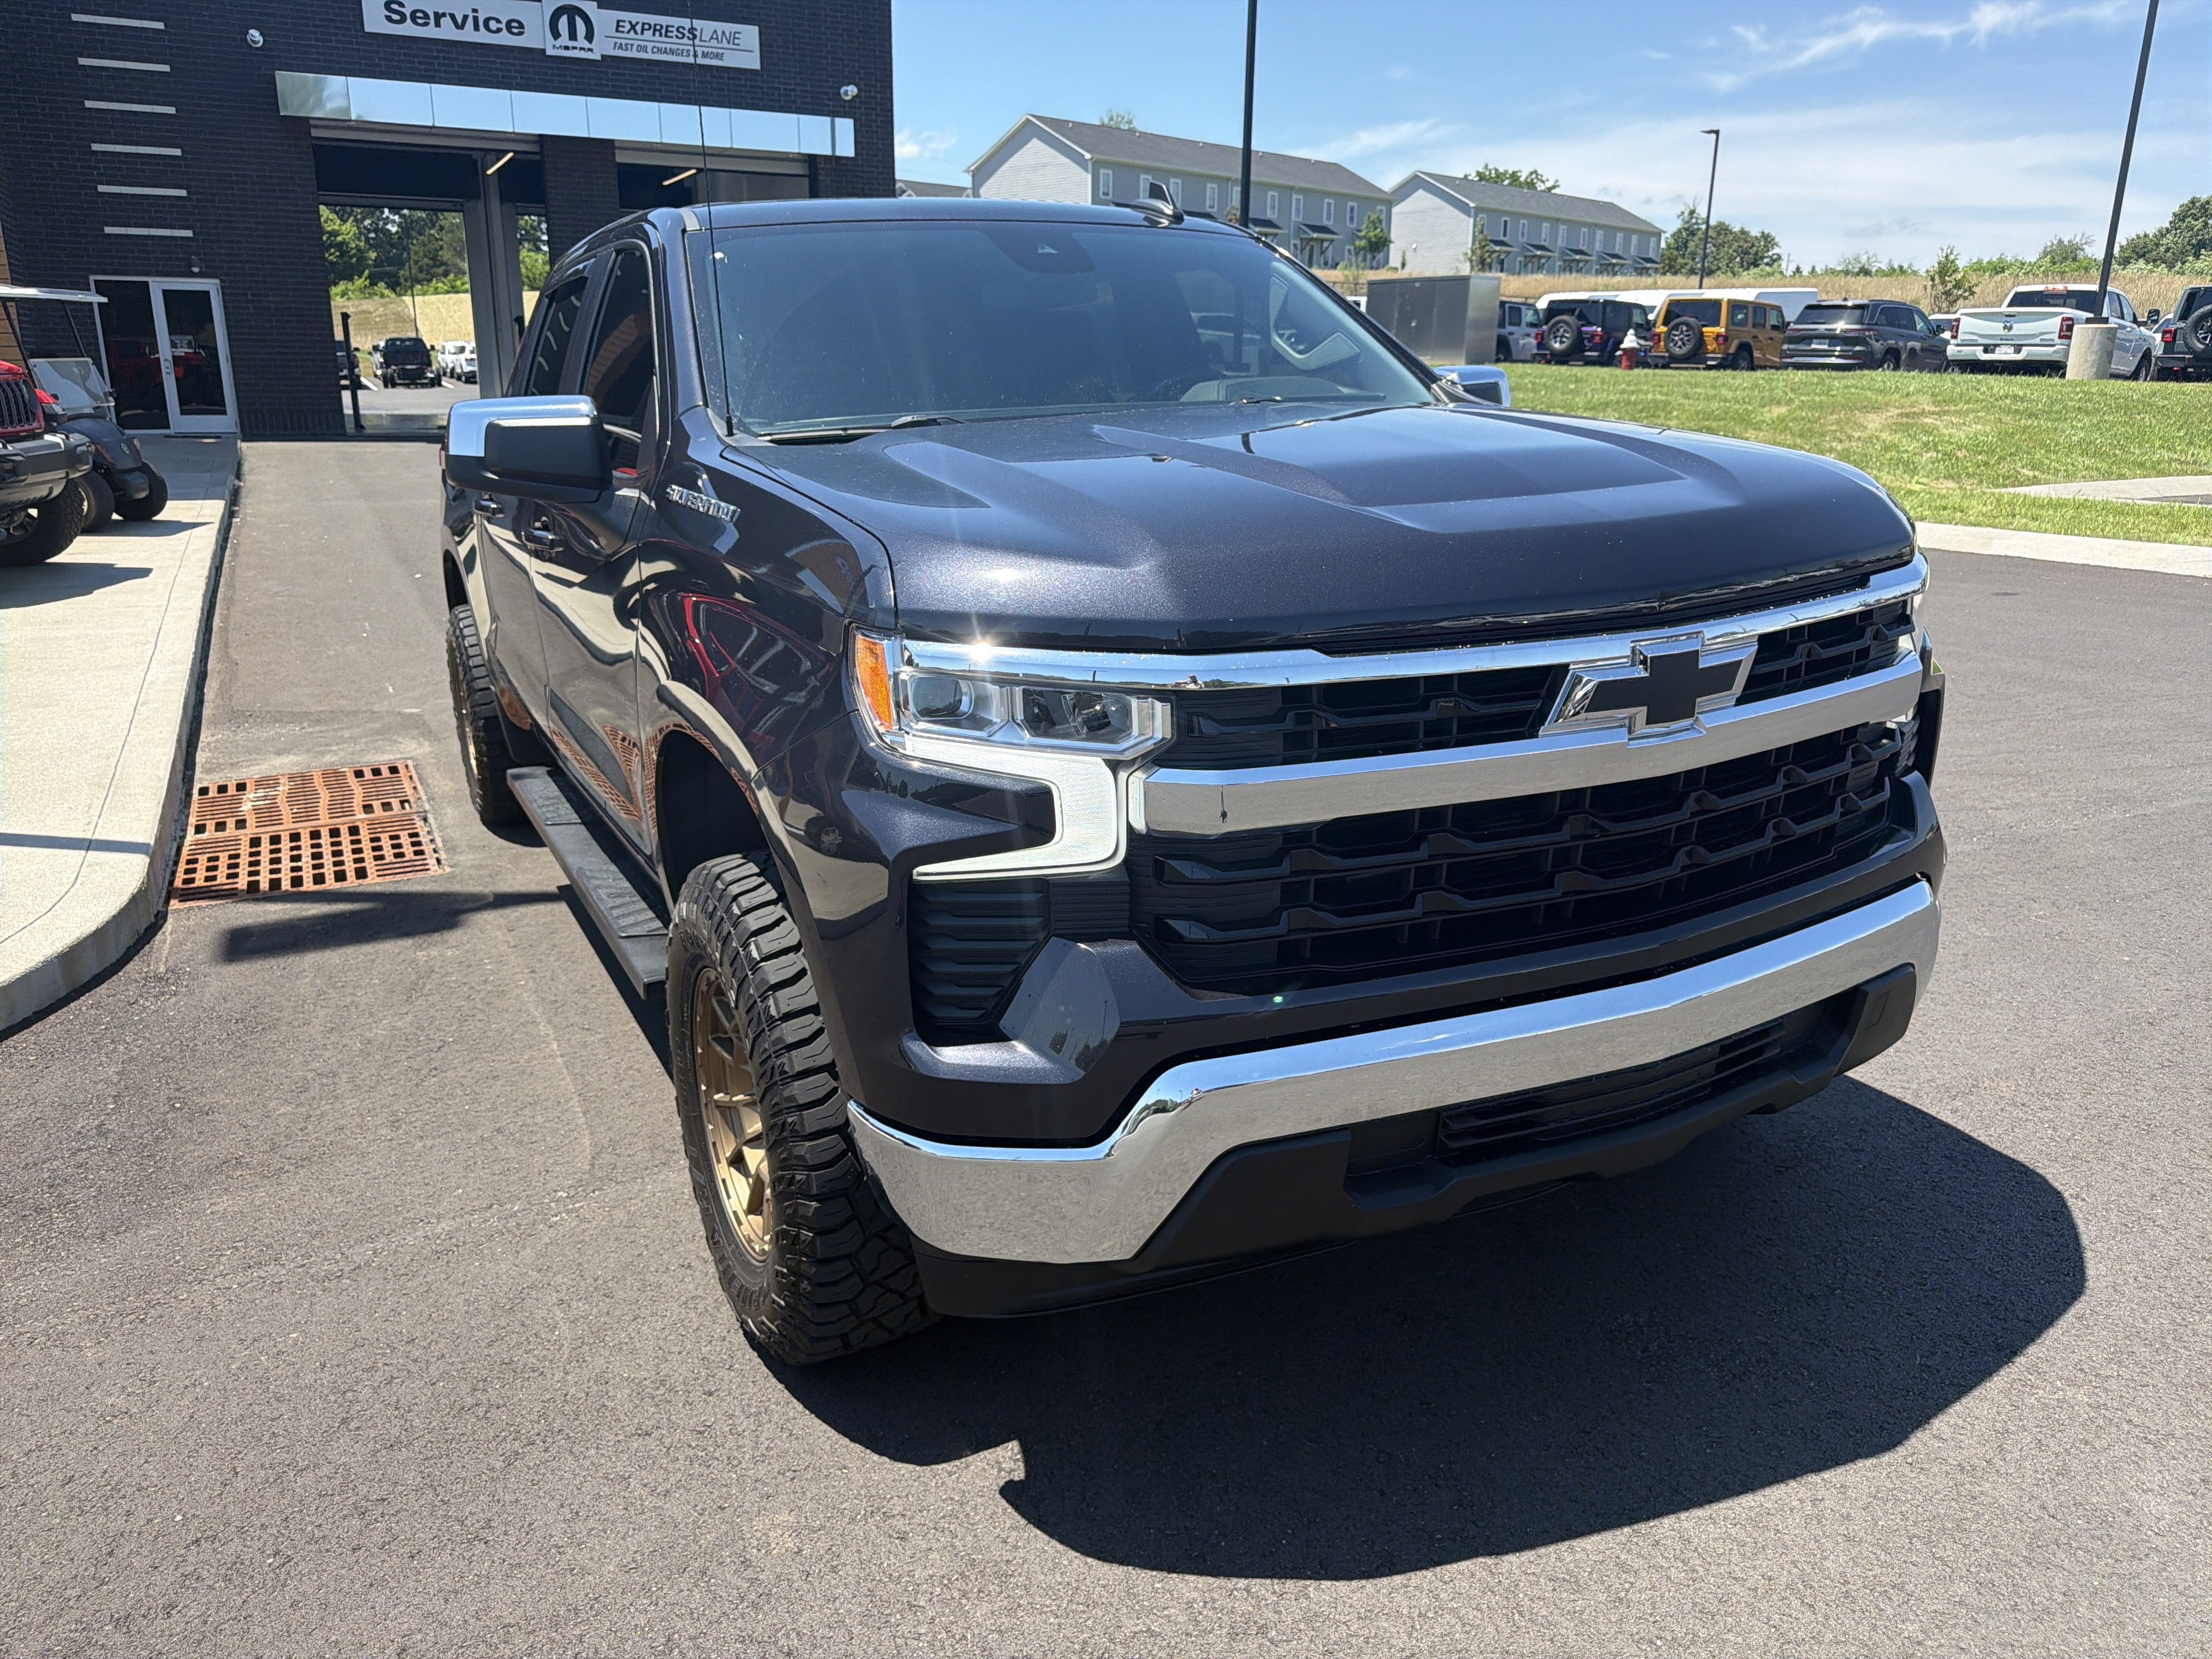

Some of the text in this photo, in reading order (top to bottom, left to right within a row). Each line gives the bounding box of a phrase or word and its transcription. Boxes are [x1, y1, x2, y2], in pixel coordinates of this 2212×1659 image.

[384, 0, 526, 36] Service
[613, 41, 633, 52] FAST
[636, 44, 649, 54] OIL
[651, 46, 691, 60] CHANGES
[701, 51, 725, 61] MORE
